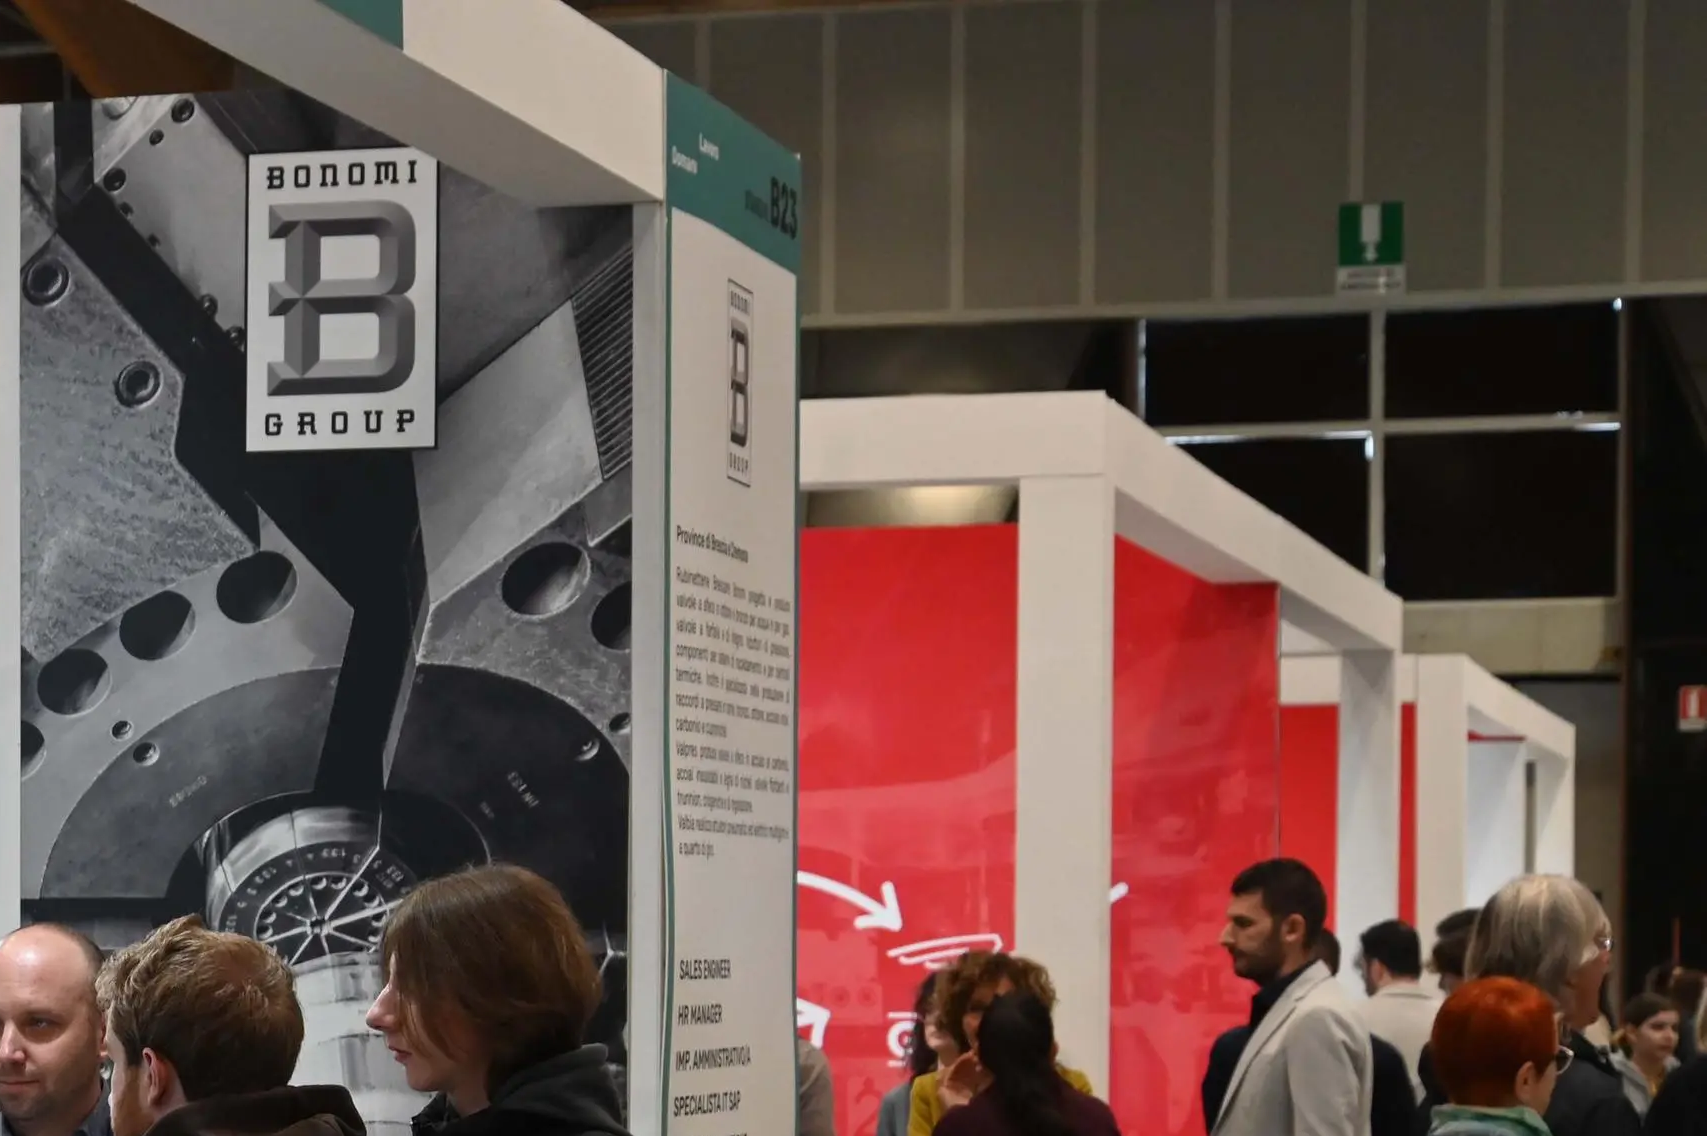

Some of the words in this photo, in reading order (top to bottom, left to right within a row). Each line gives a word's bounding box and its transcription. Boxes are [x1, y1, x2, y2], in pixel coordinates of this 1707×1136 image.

[266, 160, 419, 190] BONOMI
[770, 176, 798, 239] B23
[268, 200, 416, 396] B
[265, 409, 417, 437] GROUP
[680, 960, 703, 980] SALES
[678, 1005, 689, 1026] HR
[691, 1004, 723, 1026] MANAGER
[673, 1093, 721, 1118] SPECIALISTA
[729, 1090, 741, 1112] SAP
